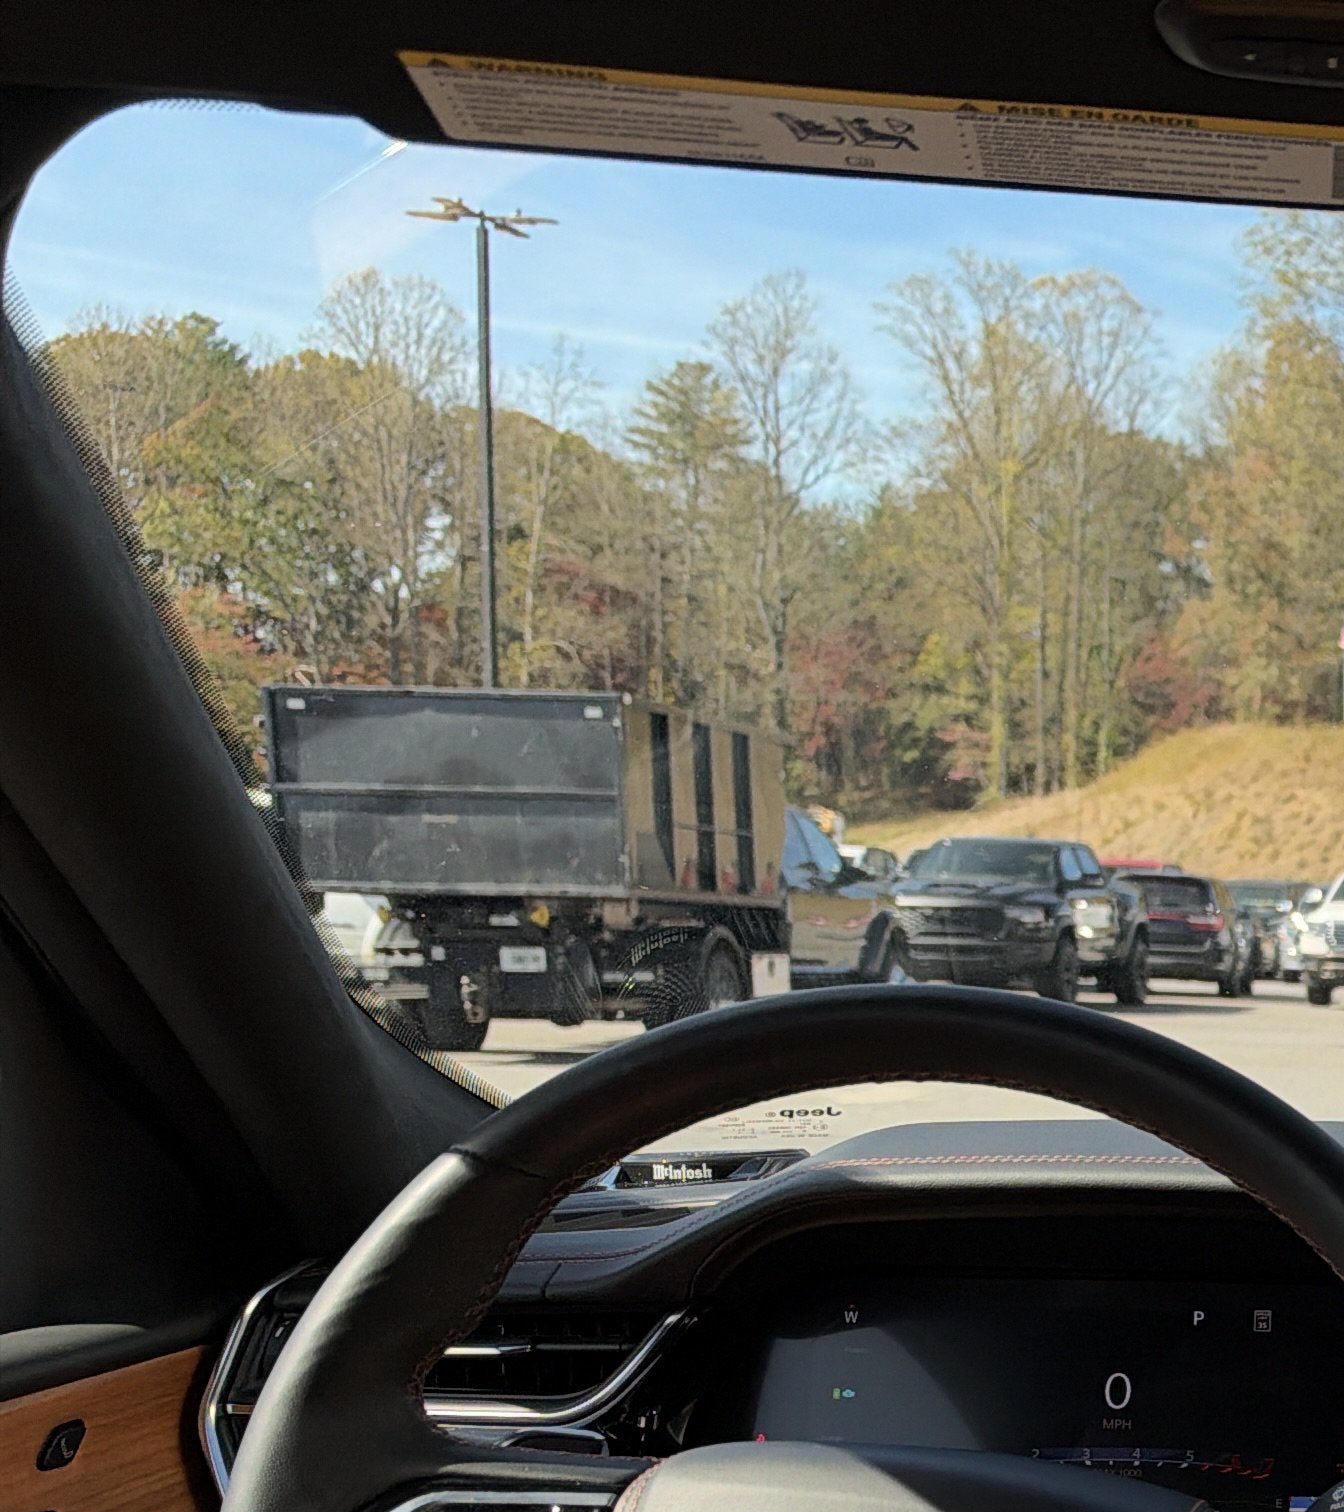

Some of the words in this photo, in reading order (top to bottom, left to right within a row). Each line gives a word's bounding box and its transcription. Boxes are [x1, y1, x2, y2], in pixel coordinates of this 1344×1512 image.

[468, 59, 608, 81] WARNING
[997, 104, 1063, 119] MISE
[1110, 112, 1199, 129] GARDE
[652, 1163, 713, 1182] McIntosh
[844, 1311, 858, 1323] W
[1193, 1311, 1205, 1325] P
[1104, 1372, 1132, 1410] 0
[1102, 1418, 1133, 1430] MPH
[1083, 1448, 1091, 1459] 3
[1132, 1448, 1141, 1459] 4
[1186, 1450, 1195, 1461] 5
